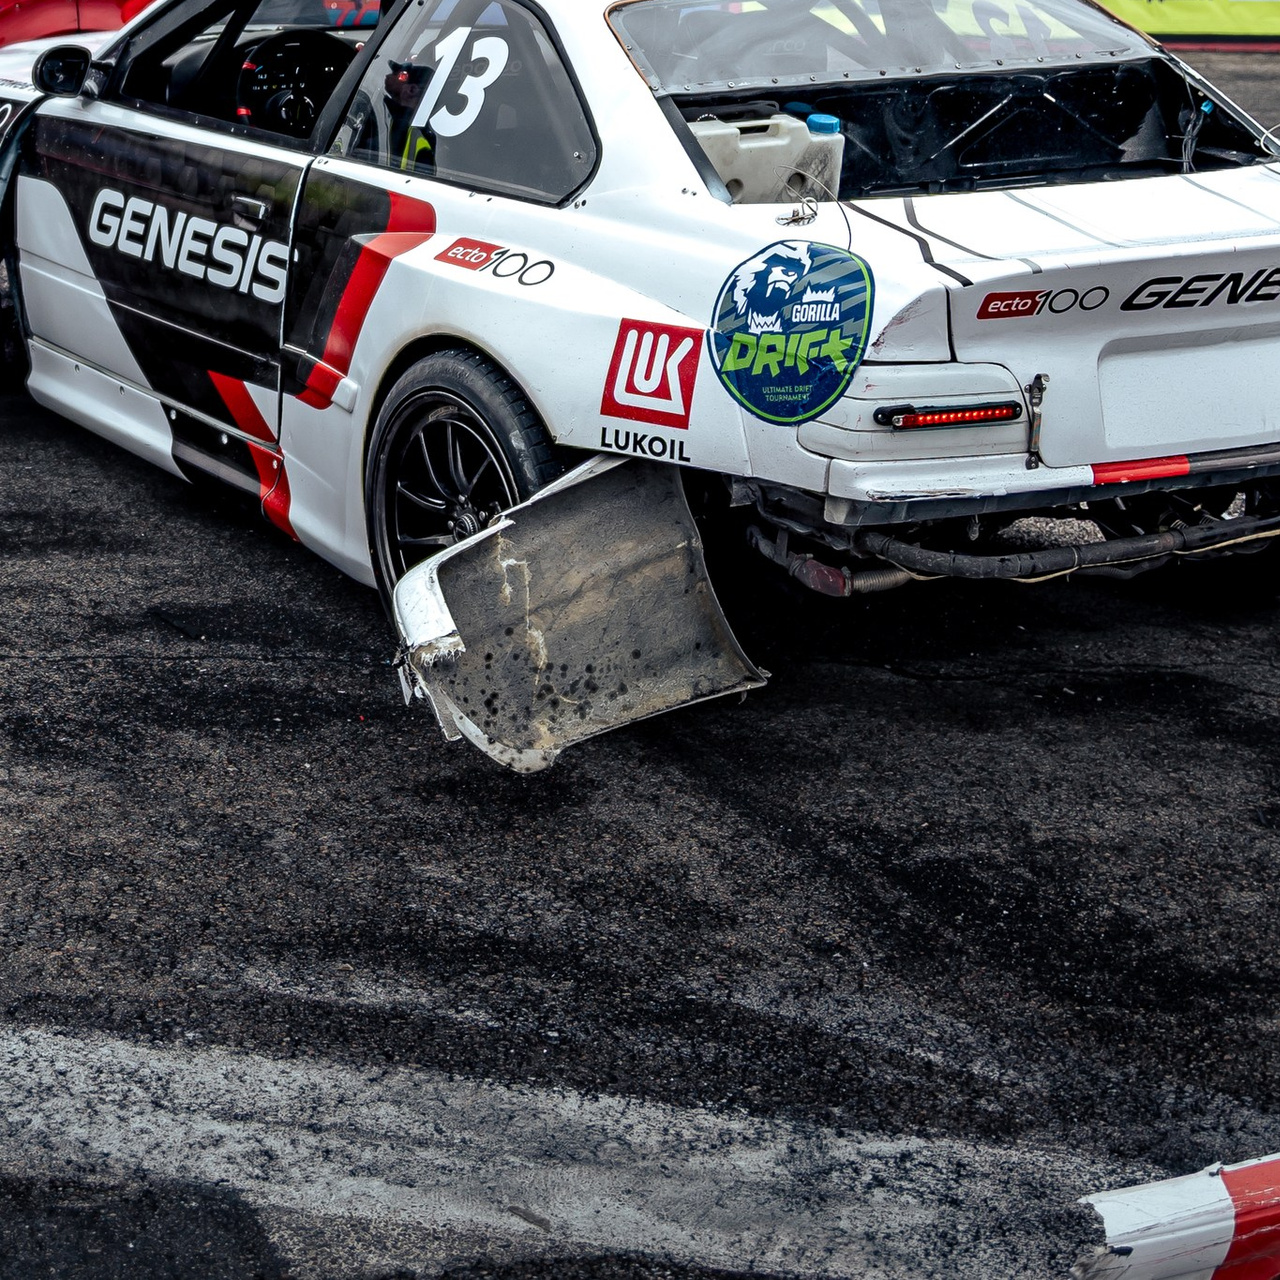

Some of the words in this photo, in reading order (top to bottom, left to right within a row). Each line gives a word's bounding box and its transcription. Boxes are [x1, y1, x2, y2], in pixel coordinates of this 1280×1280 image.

[411, 26, 510, 138] 13
[89, 188, 290, 304] GENESIS
[792, 303, 840, 323] GORILLA
[721, 328, 855, 378] DRIFT
[762, 385, 793, 395] ULTIMATE
[794, 384, 814, 393] DRIFT
[765, 393, 811, 402] TOURNAMENT
[600, 426, 692, 463] LUKOIL
